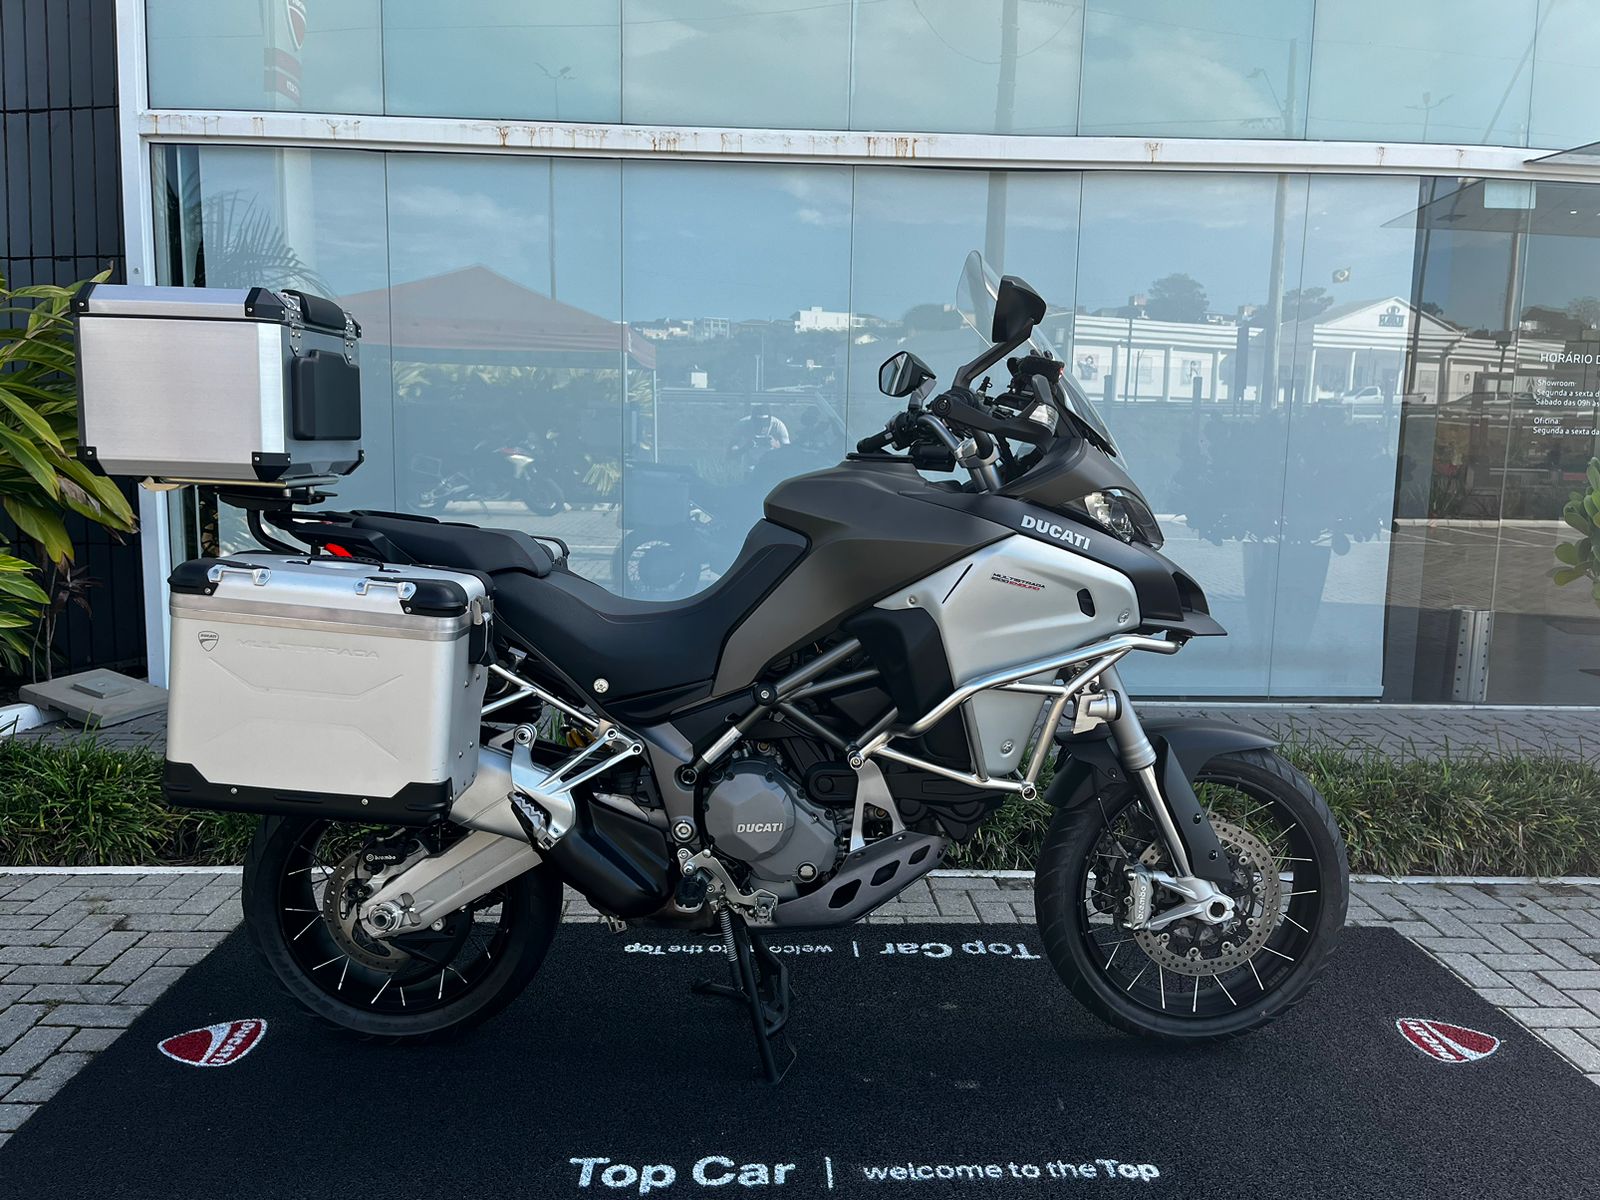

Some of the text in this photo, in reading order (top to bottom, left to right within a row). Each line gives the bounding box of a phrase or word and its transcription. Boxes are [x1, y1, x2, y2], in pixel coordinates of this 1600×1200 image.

[1540, 351, 1593, 364] HORÁRIO
[1537, 389, 1568, 398] Segunda
[1575, 390, 1594, 398] sexta
[1536, 398, 1562, 407] Sábado
[1563, 398, 1576, 407] das
[1577, 399, 1591, 407] 09h
[1532, 426, 1564, 436] Segunda
[1020, 514, 1091, 551] DUCATI
[736, 822, 784, 833] DUCATI
[1137, 885, 1147, 920] brembo
[624, 942, 666, 955] Top
[668, 944, 703, 954] the
[879, 942, 953, 959] Car
[961, 939, 1041, 960] Top
[569, 1155, 1160, 1196] Top Car welcome to the Top
